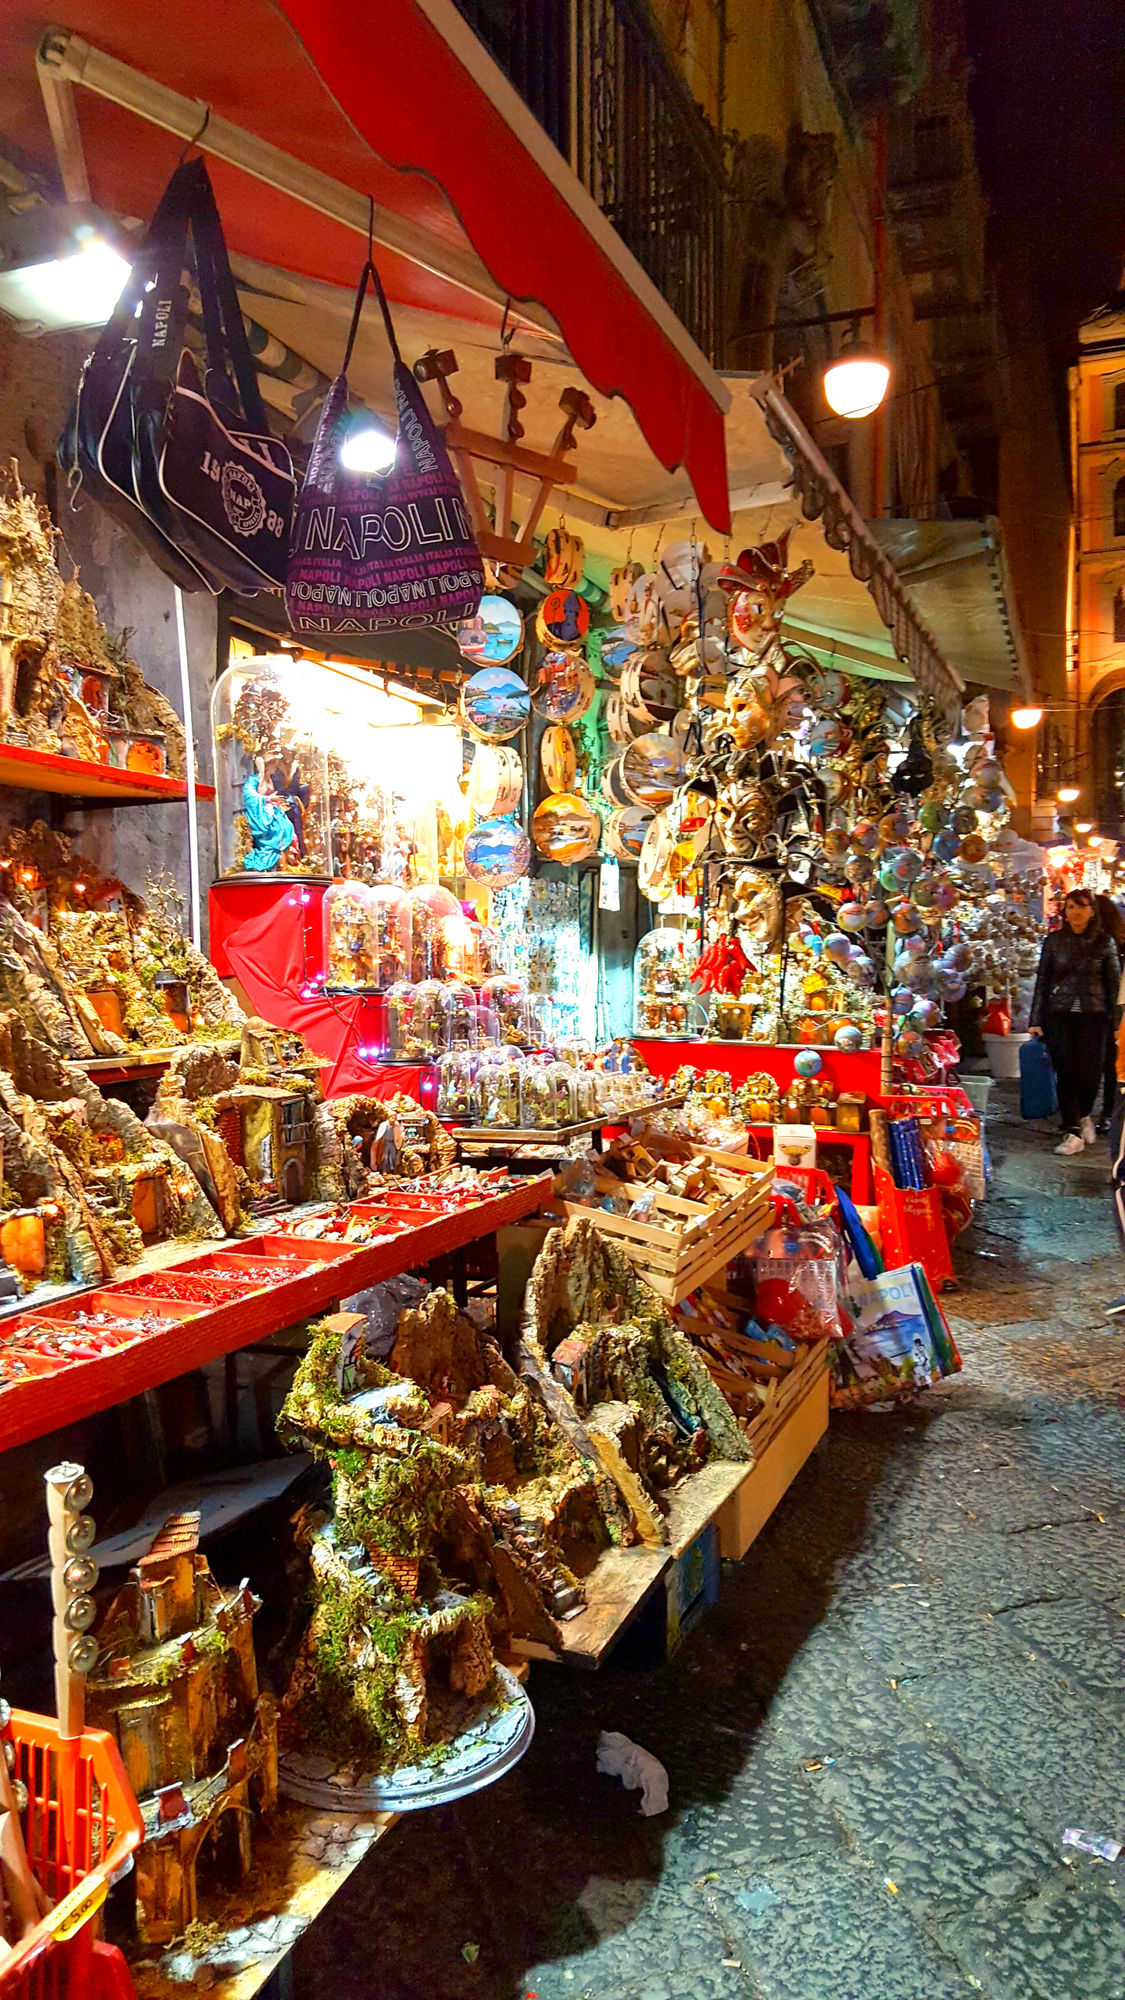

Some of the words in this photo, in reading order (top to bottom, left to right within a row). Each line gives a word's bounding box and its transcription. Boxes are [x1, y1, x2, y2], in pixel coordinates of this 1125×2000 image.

[152, 300, 172, 347] NAPOLI
[400, 408, 439, 473] NAPOLI
[200, 450, 221, 482] 19
[267, 509, 285, 538] 88
[304, 497, 454, 560] NAPOLI
[299, 569, 341, 583] NAPOLI
[383, 566, 426, 584] NAPOLI
[313, 557, 342, 568] ITALIA
[425, 549, 454, 561] ITALIA
[299, 602, 475, 632] NAPOLI
[858, 1282, 915, 1306] NAPOLI
